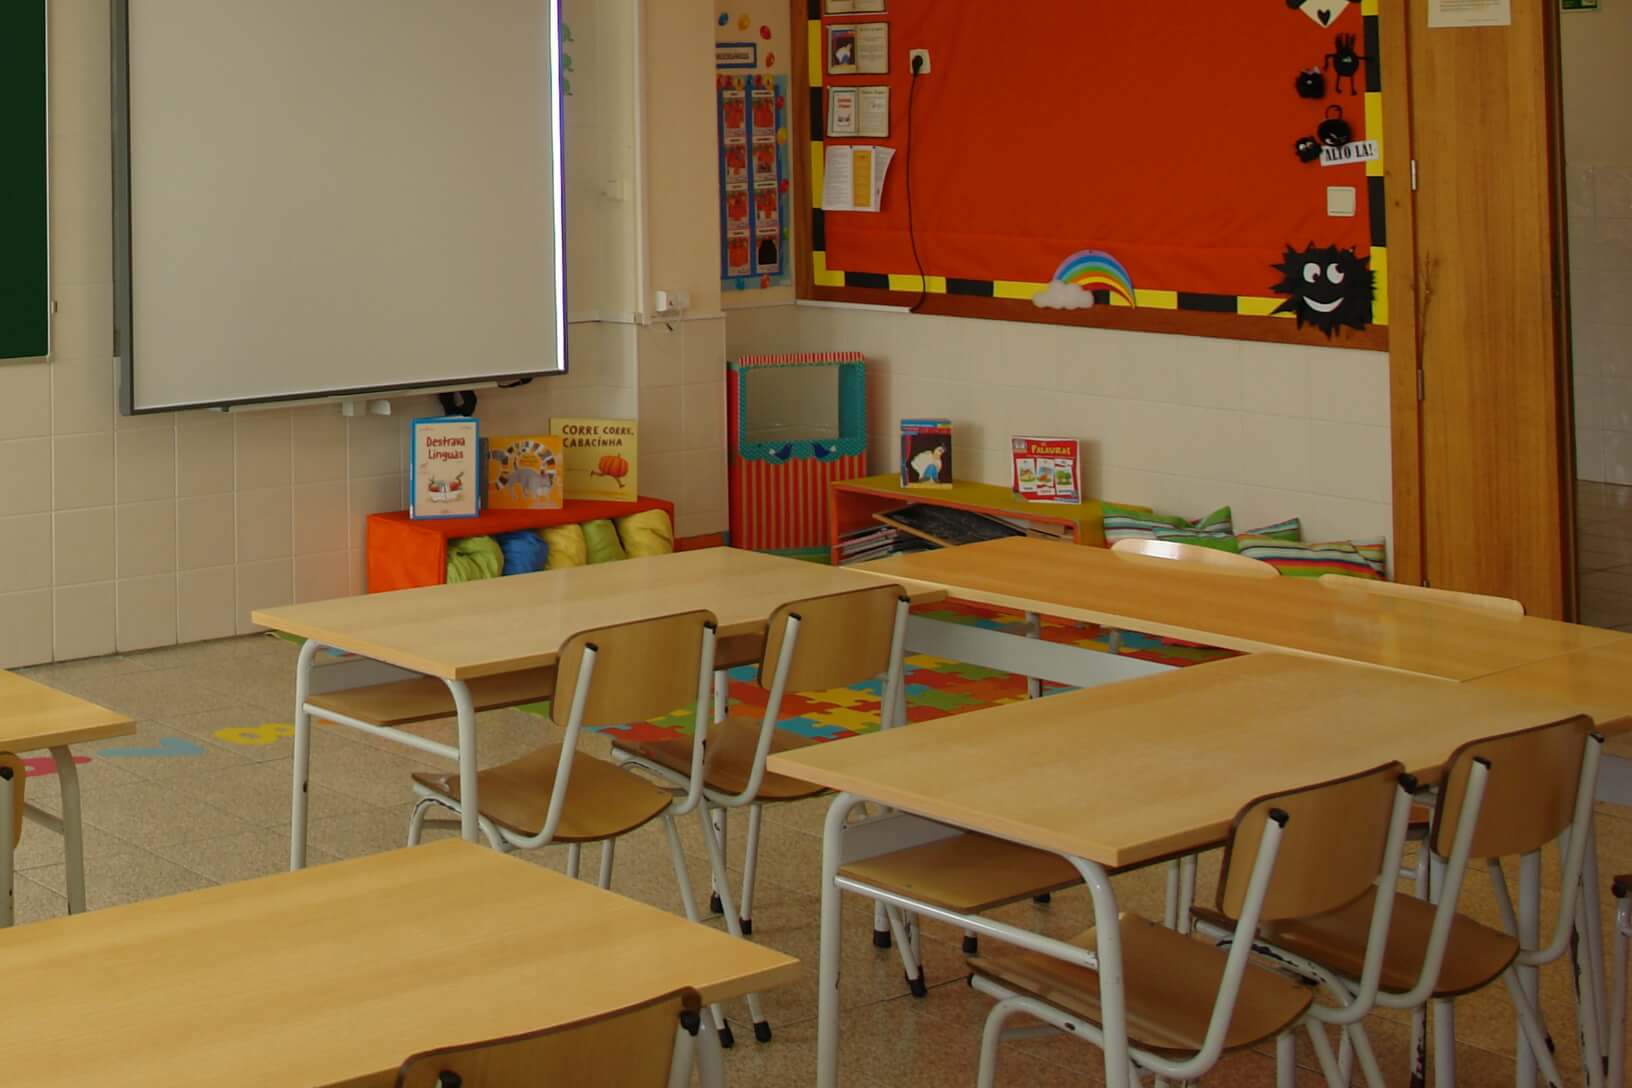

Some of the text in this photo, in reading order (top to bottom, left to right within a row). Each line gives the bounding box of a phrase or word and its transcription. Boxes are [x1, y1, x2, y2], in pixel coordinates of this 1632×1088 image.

[1326, 145, 1351, 160] ALTO
[562, 424, 599, 435] CORRE
[426, 436, 464, 447] Destrava
